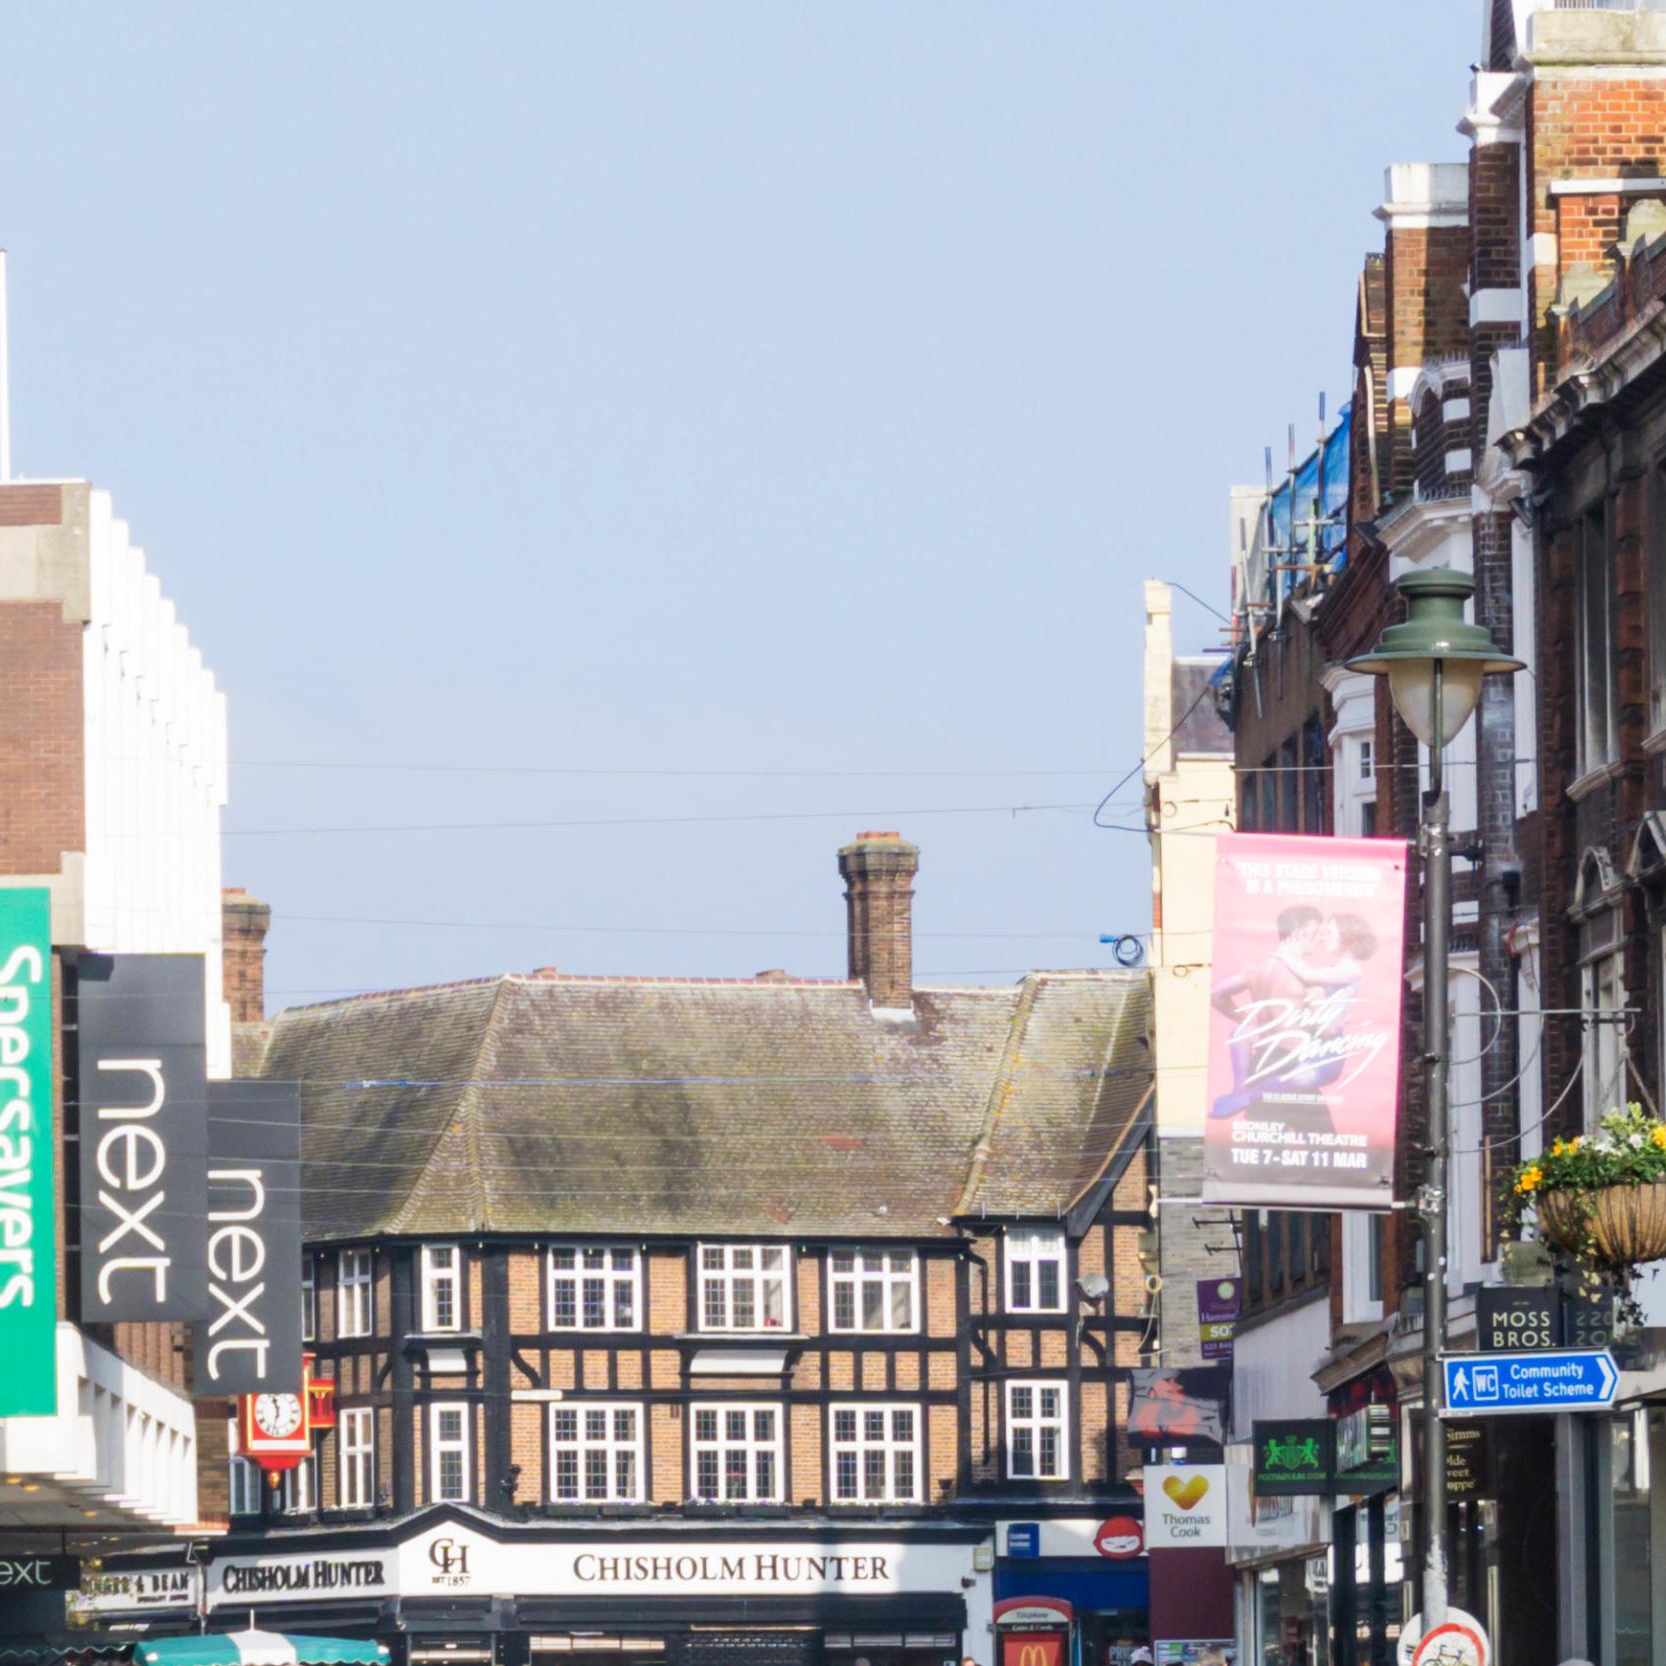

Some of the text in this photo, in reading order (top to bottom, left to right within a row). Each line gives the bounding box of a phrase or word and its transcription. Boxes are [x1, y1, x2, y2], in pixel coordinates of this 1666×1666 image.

[1224, 986, 1373, 1046] Dirty
[1243, 1019, 1389, 1090] Dancing
[1231, 1129, 1367, 1147] CHURCHILL THEATRE
[1230, 1147, 1260, 1164] TUE
[1312, 1150, 1330, 1166] 11
[1333, 1151, 1367, 1168] MAR
[96, 1058, 172, 1305] next
[206, 1168, 273, 1381] next
[1493, 1311, 1551, 1328] MOSS
[1493, 1331, 1556, 1348] BROS.
[1476, 1362, 1584, 1392] WC Community
[1502, 1381, 1594, 1400] Toilet Scheme
[1446, 1455, 1467, 1467] lde
[1162, 1513, 1211, 1526] Thomas
[1170, 1526, 1202, 1538] Cook
[152, 1572, 190, 1592] BEAN
[447, 1575, 471, 1588] 1857
